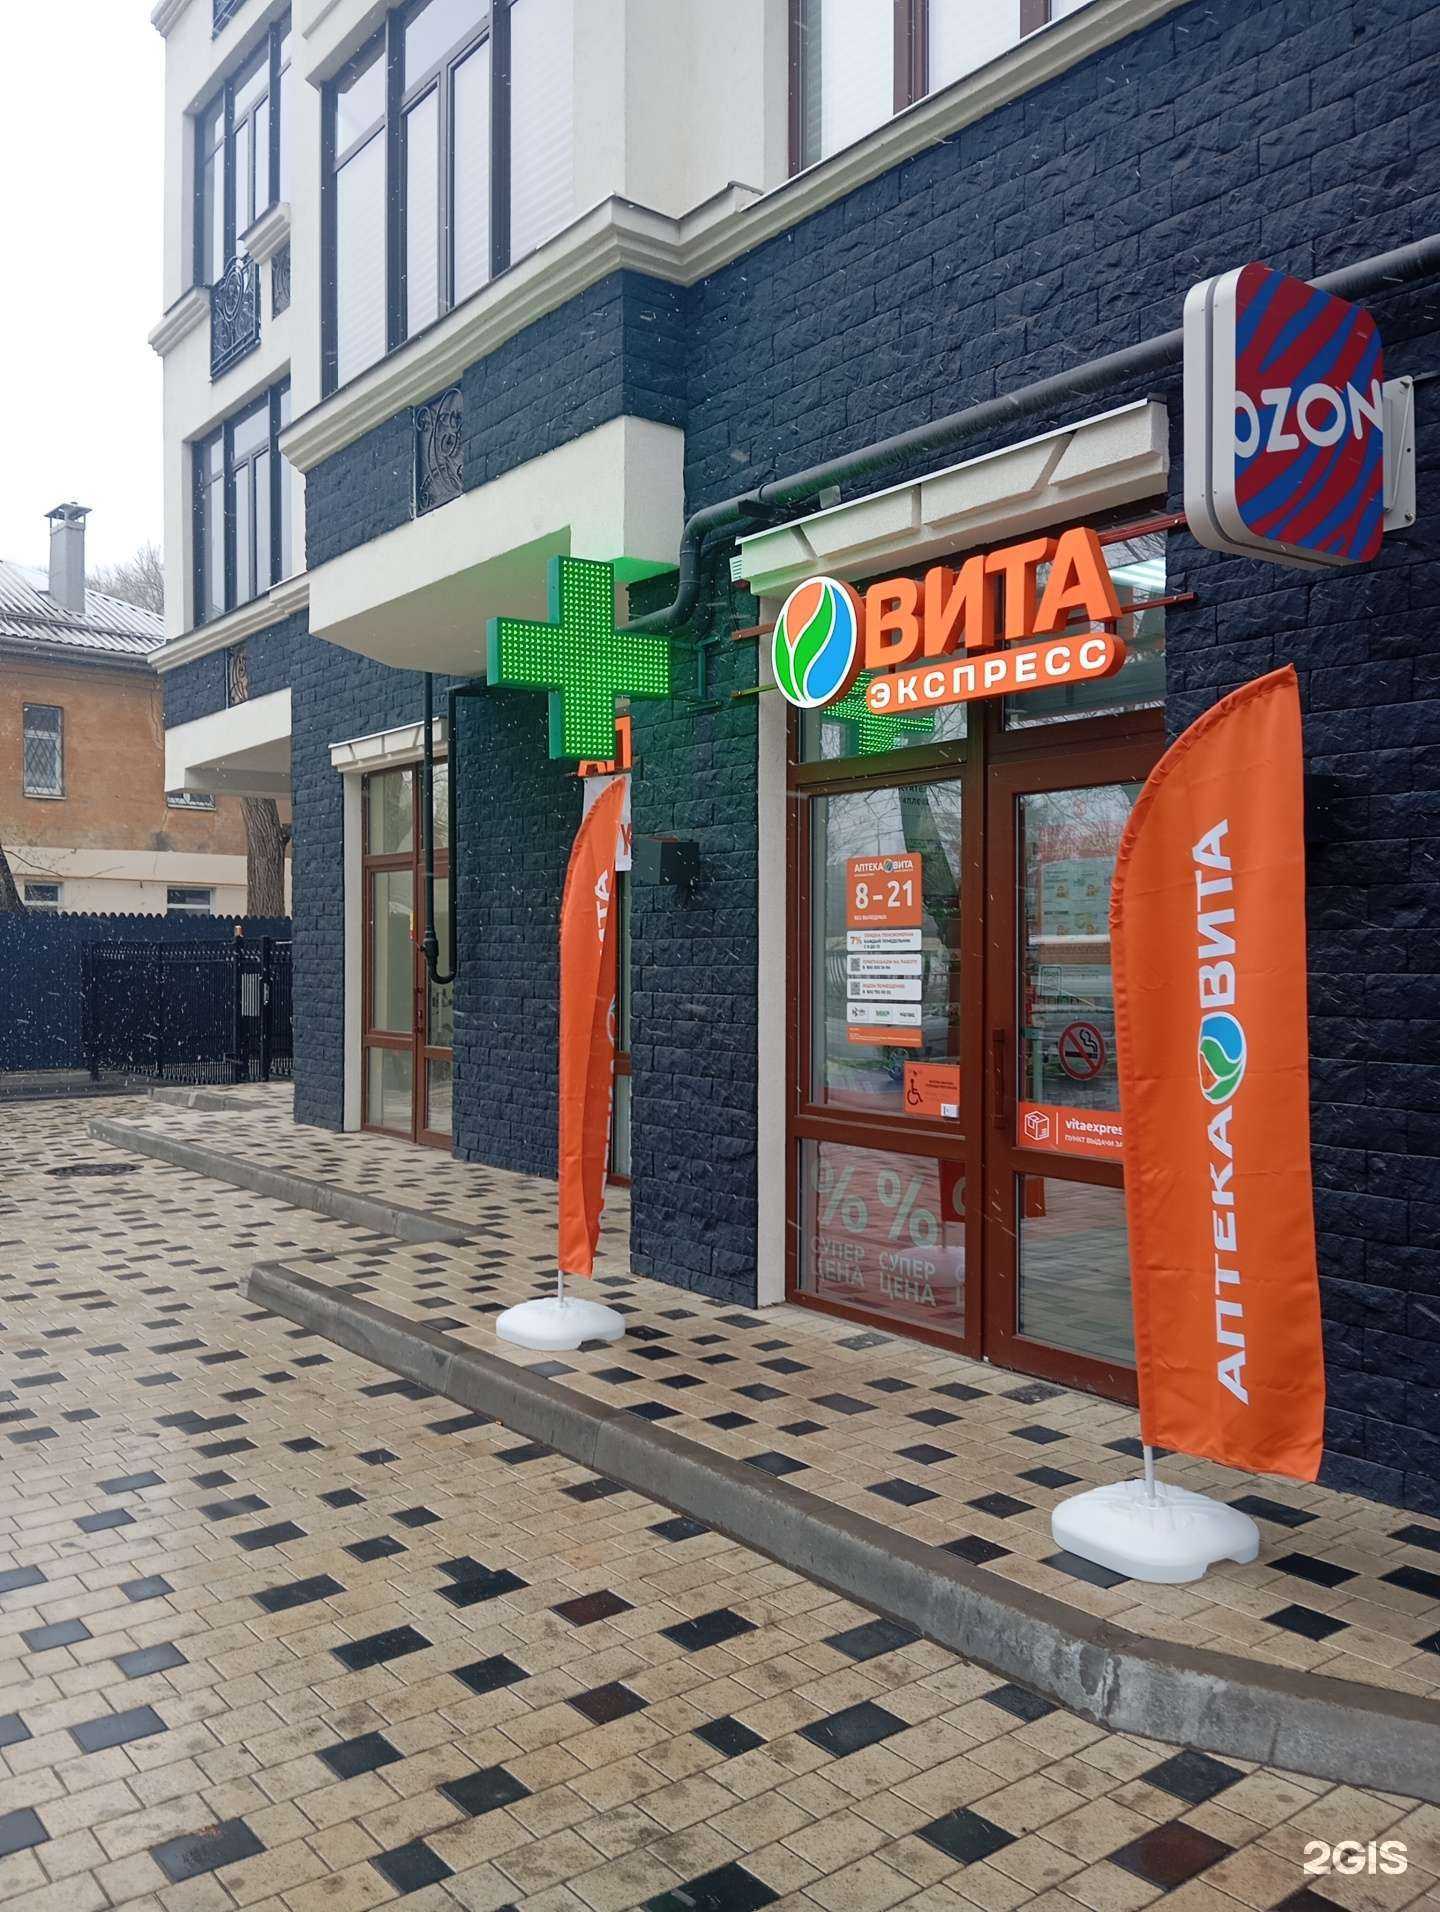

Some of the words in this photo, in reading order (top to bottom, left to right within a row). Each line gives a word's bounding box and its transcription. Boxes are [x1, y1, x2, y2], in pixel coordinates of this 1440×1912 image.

[1234, 378, 1384, 458] OZON
[864, 526, 1122, 669] ВИТА
[870, 638, 1107, 709] ЭКСПРЕСС
[854, 862, 882, 873] АПТЕКА
[892, 860, 913, 870] ВИТА
[855, 882, 869, 909] 8
[887, 880, 912, 907] 21
[1192, 818, 1236, 1008] ВИТА
[879, 1252, 936, 1281] СУПЕР
[880, 1273, 937, 1307] ЦЕНА
[1206, 1105, 1249, 1406] АПТЕКА
